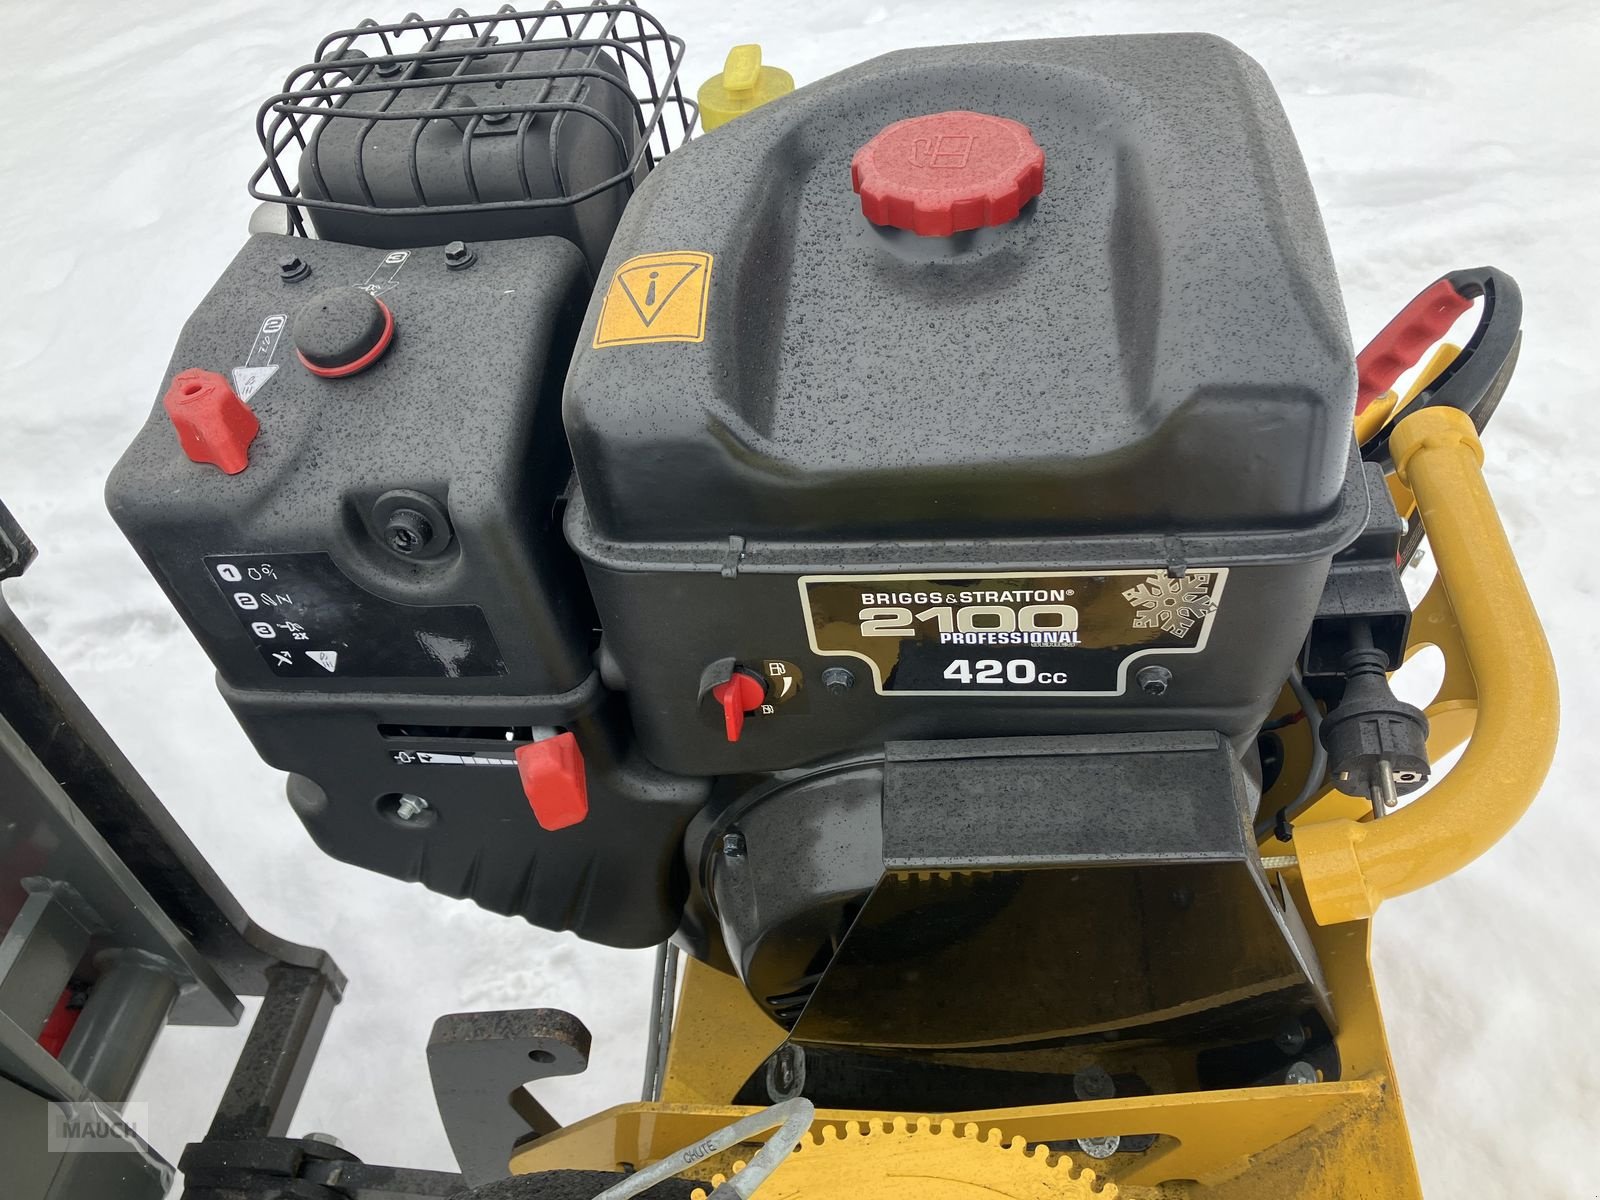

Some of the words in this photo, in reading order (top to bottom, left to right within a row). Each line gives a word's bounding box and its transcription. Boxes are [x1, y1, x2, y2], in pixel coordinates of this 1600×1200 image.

[858, 604, 1079, 637] 2100
[940, 631, 1082, 645] PROFESSIONAL
[683, 1139, 717, 1164] CHUTE
